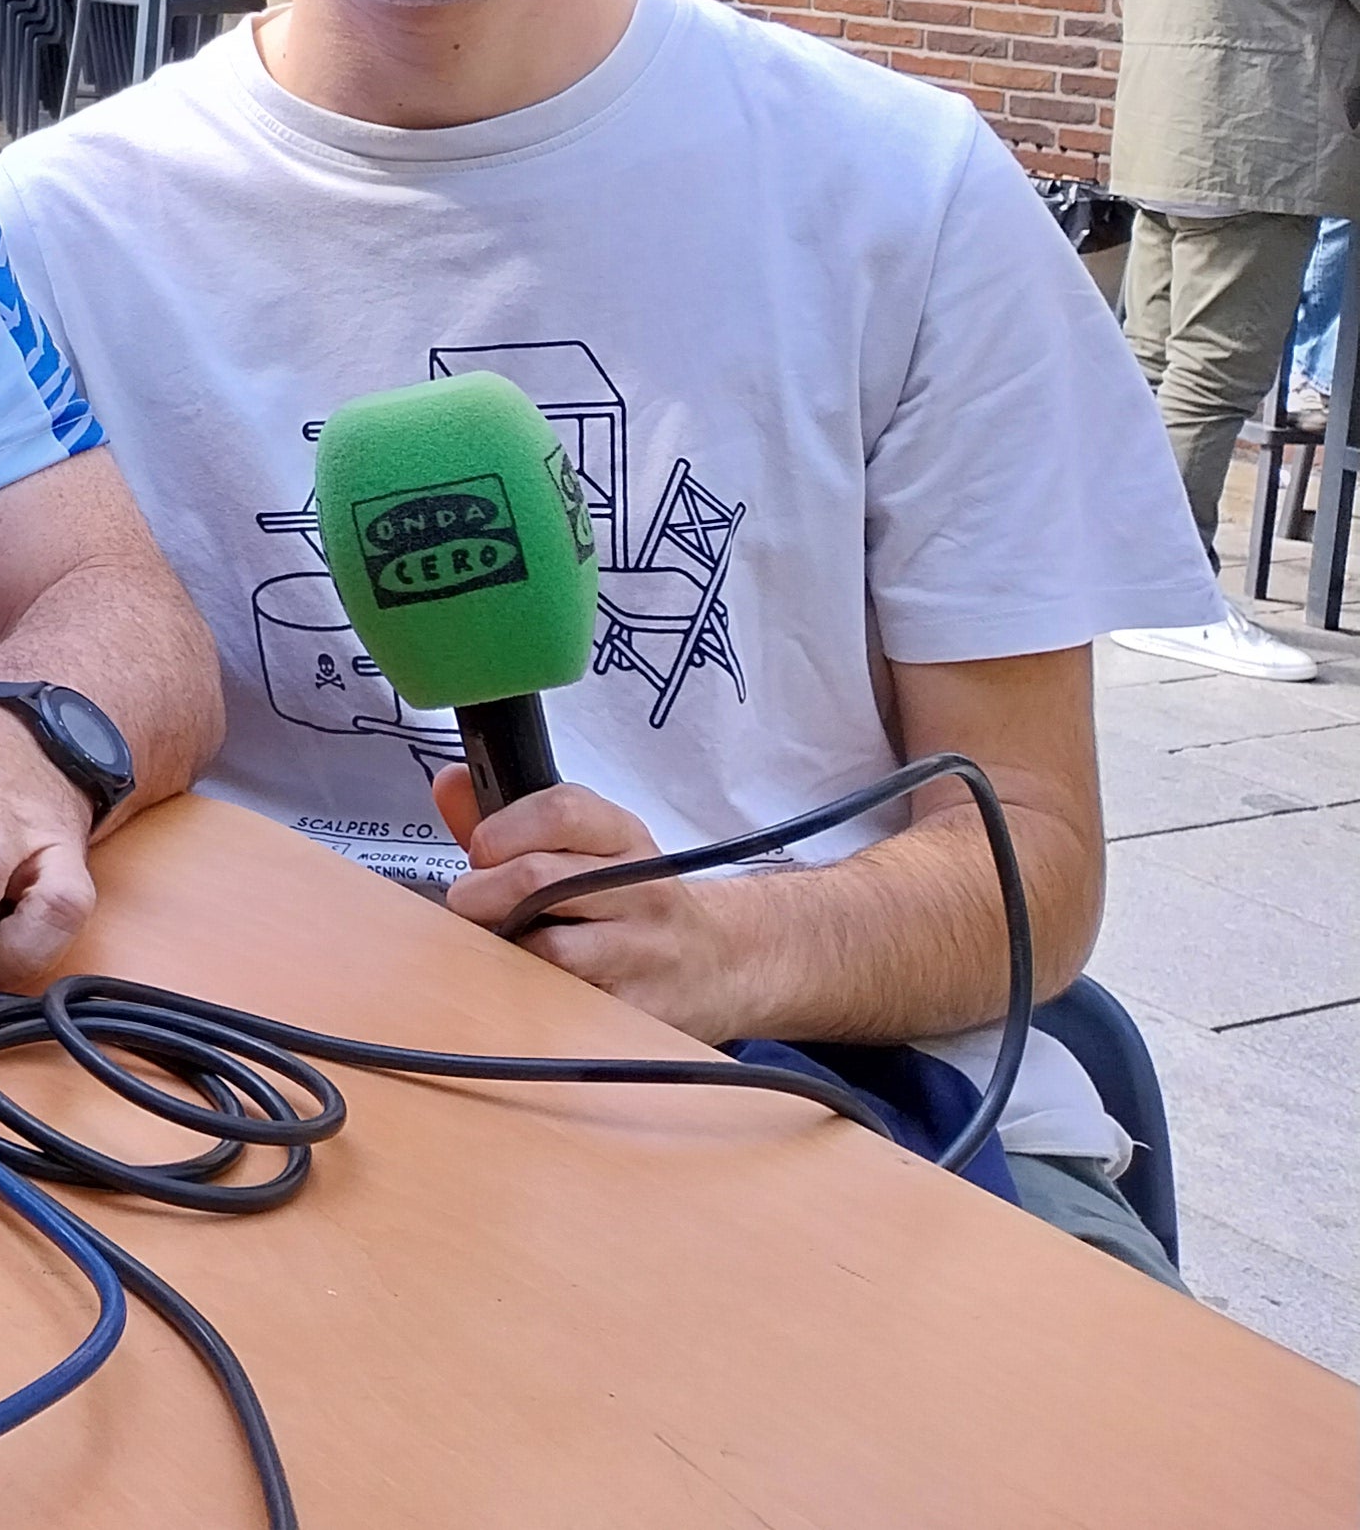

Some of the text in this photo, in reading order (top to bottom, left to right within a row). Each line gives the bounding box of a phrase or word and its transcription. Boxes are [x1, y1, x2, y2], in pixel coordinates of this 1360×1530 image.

[380, 503, 488, 542] ONDA
[393, 543, 499, 587] CERO
[296, 816, 439, 841] SCALPERS CO.
[356, 852, 419, 864] MODERN
[426, 870, 444, 883] AT
